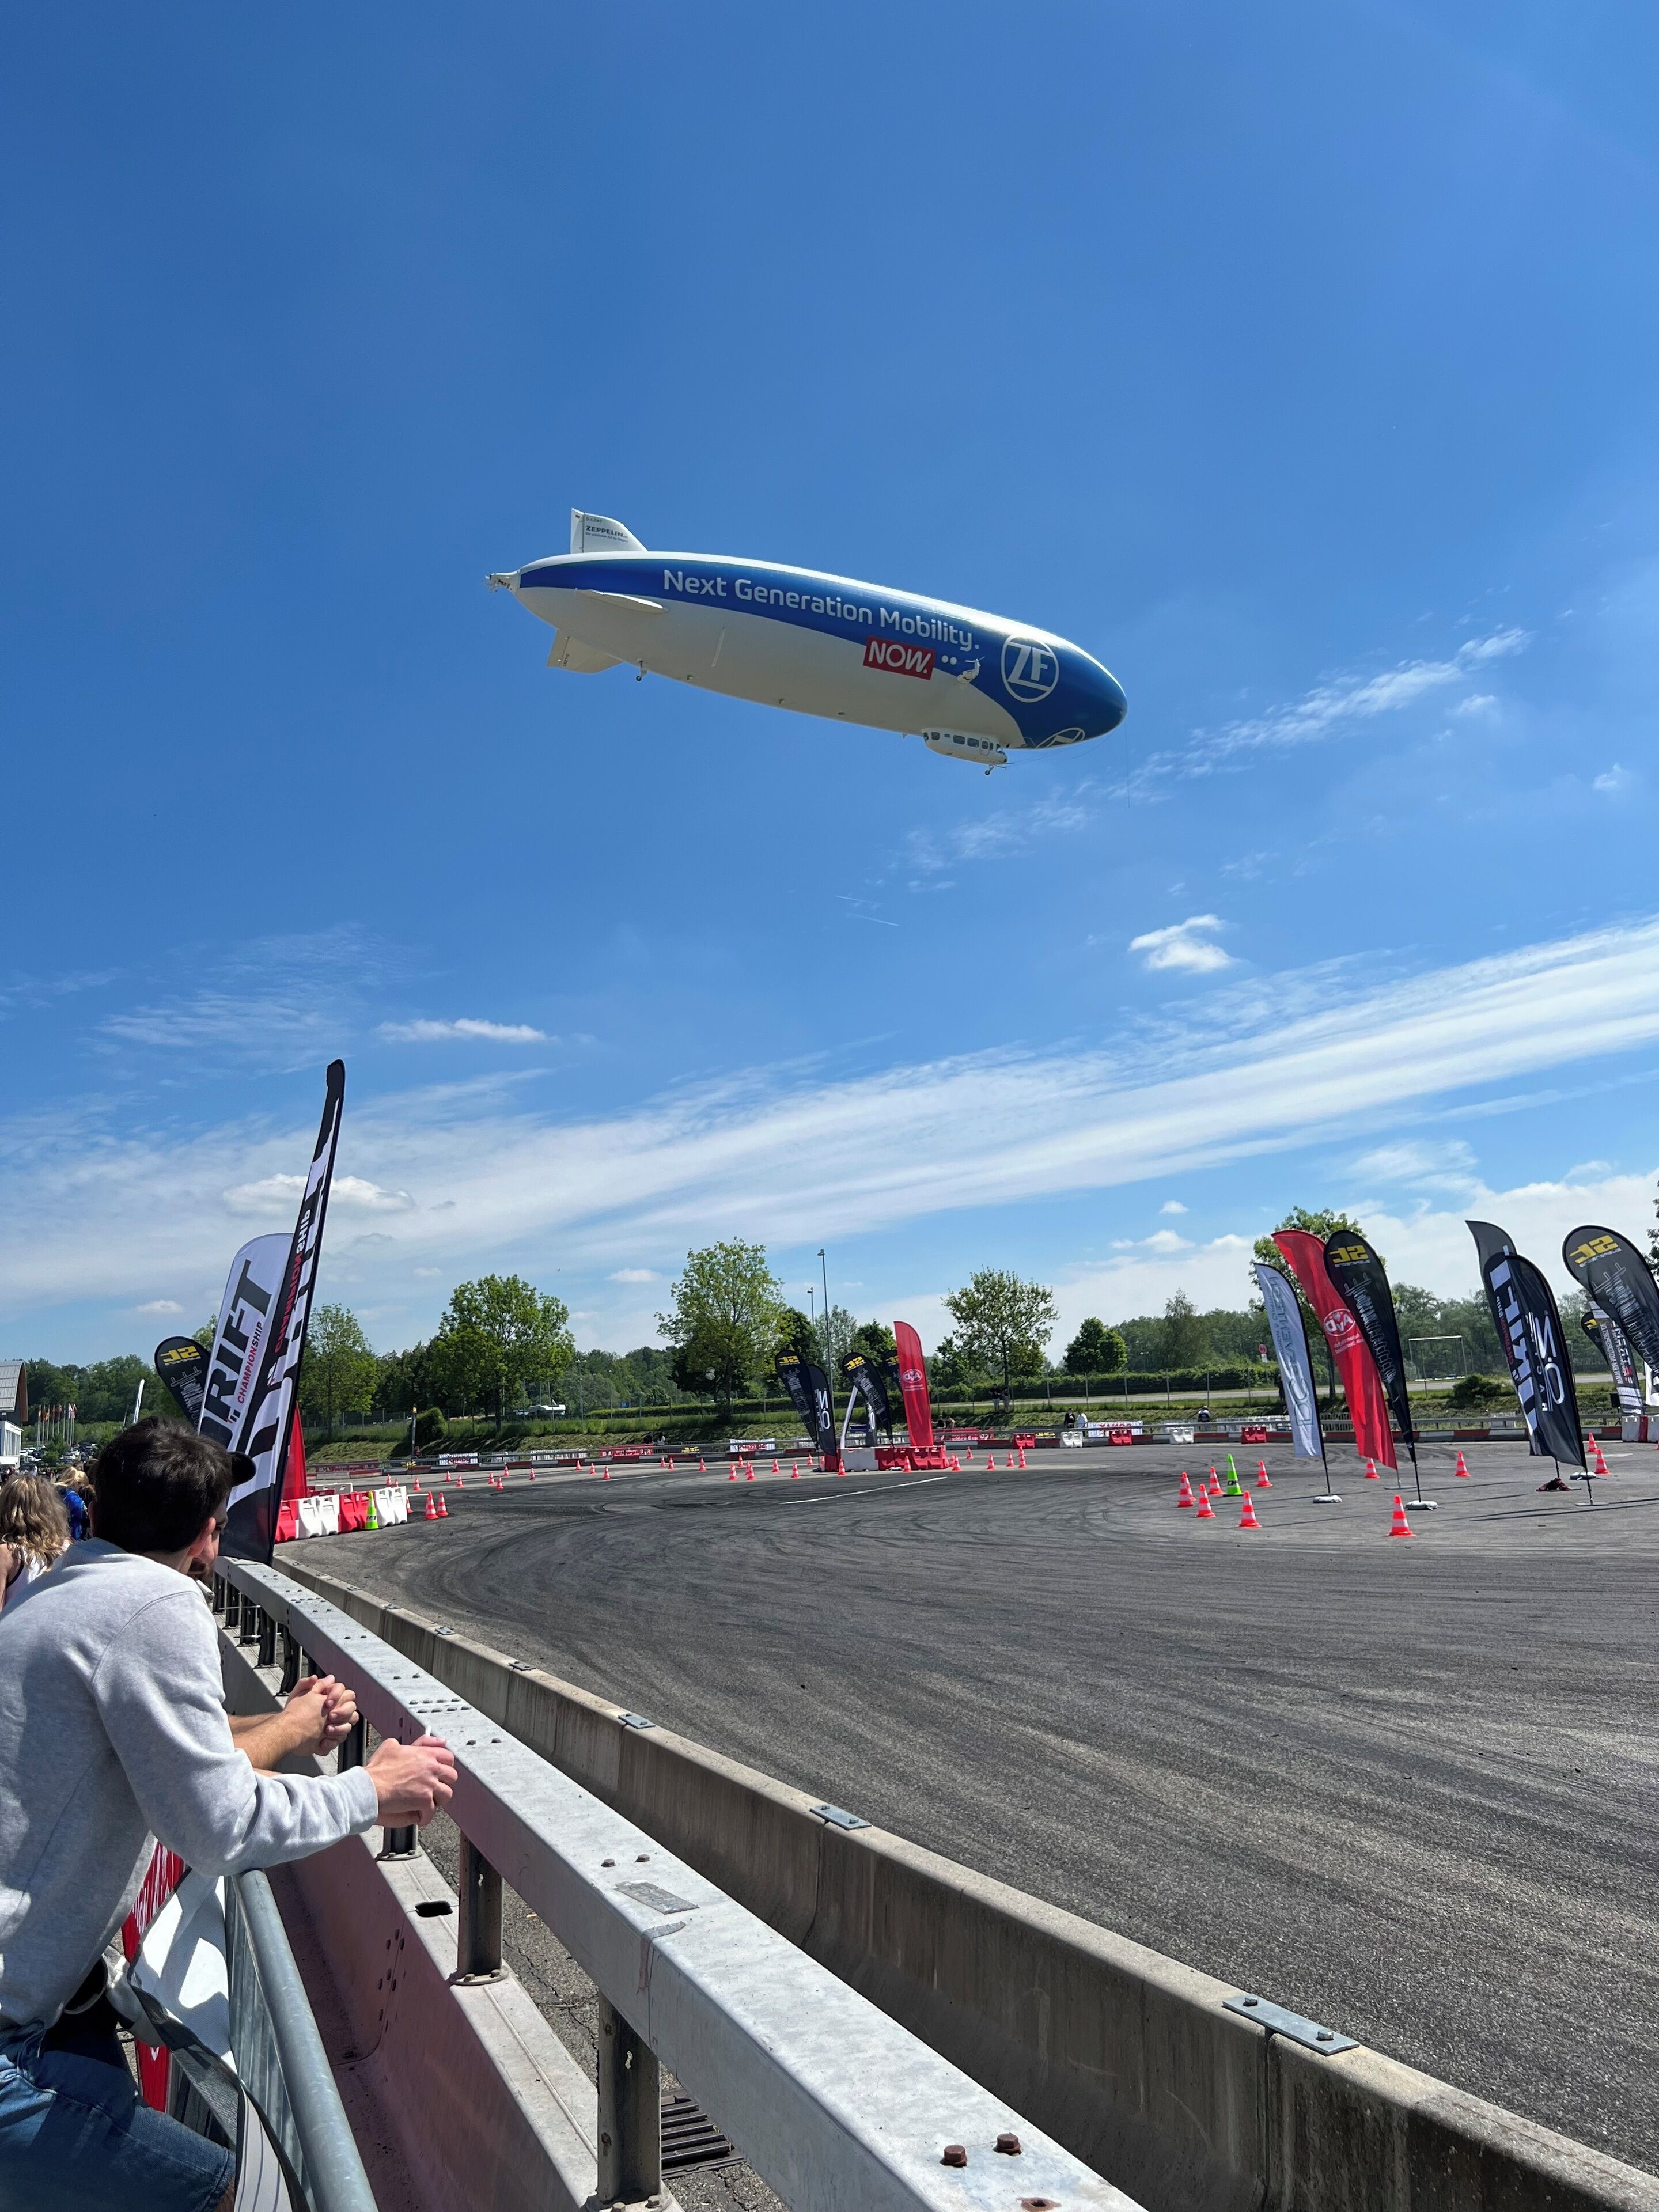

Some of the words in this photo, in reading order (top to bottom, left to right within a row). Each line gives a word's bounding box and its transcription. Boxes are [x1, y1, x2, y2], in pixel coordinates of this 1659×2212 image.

[585, 525, 623, 537] ZEPPELIN
[664, 569, 727, 597] Next
[734, 578, 873, 625] Generation
[880, 607, 980, 652] Mobility.
[868, 641, 932, 674] NOW.
[1006, 641, 1055, 692] ZF
[237, 1320, 263, 1405] CHAMPIONSHIP
